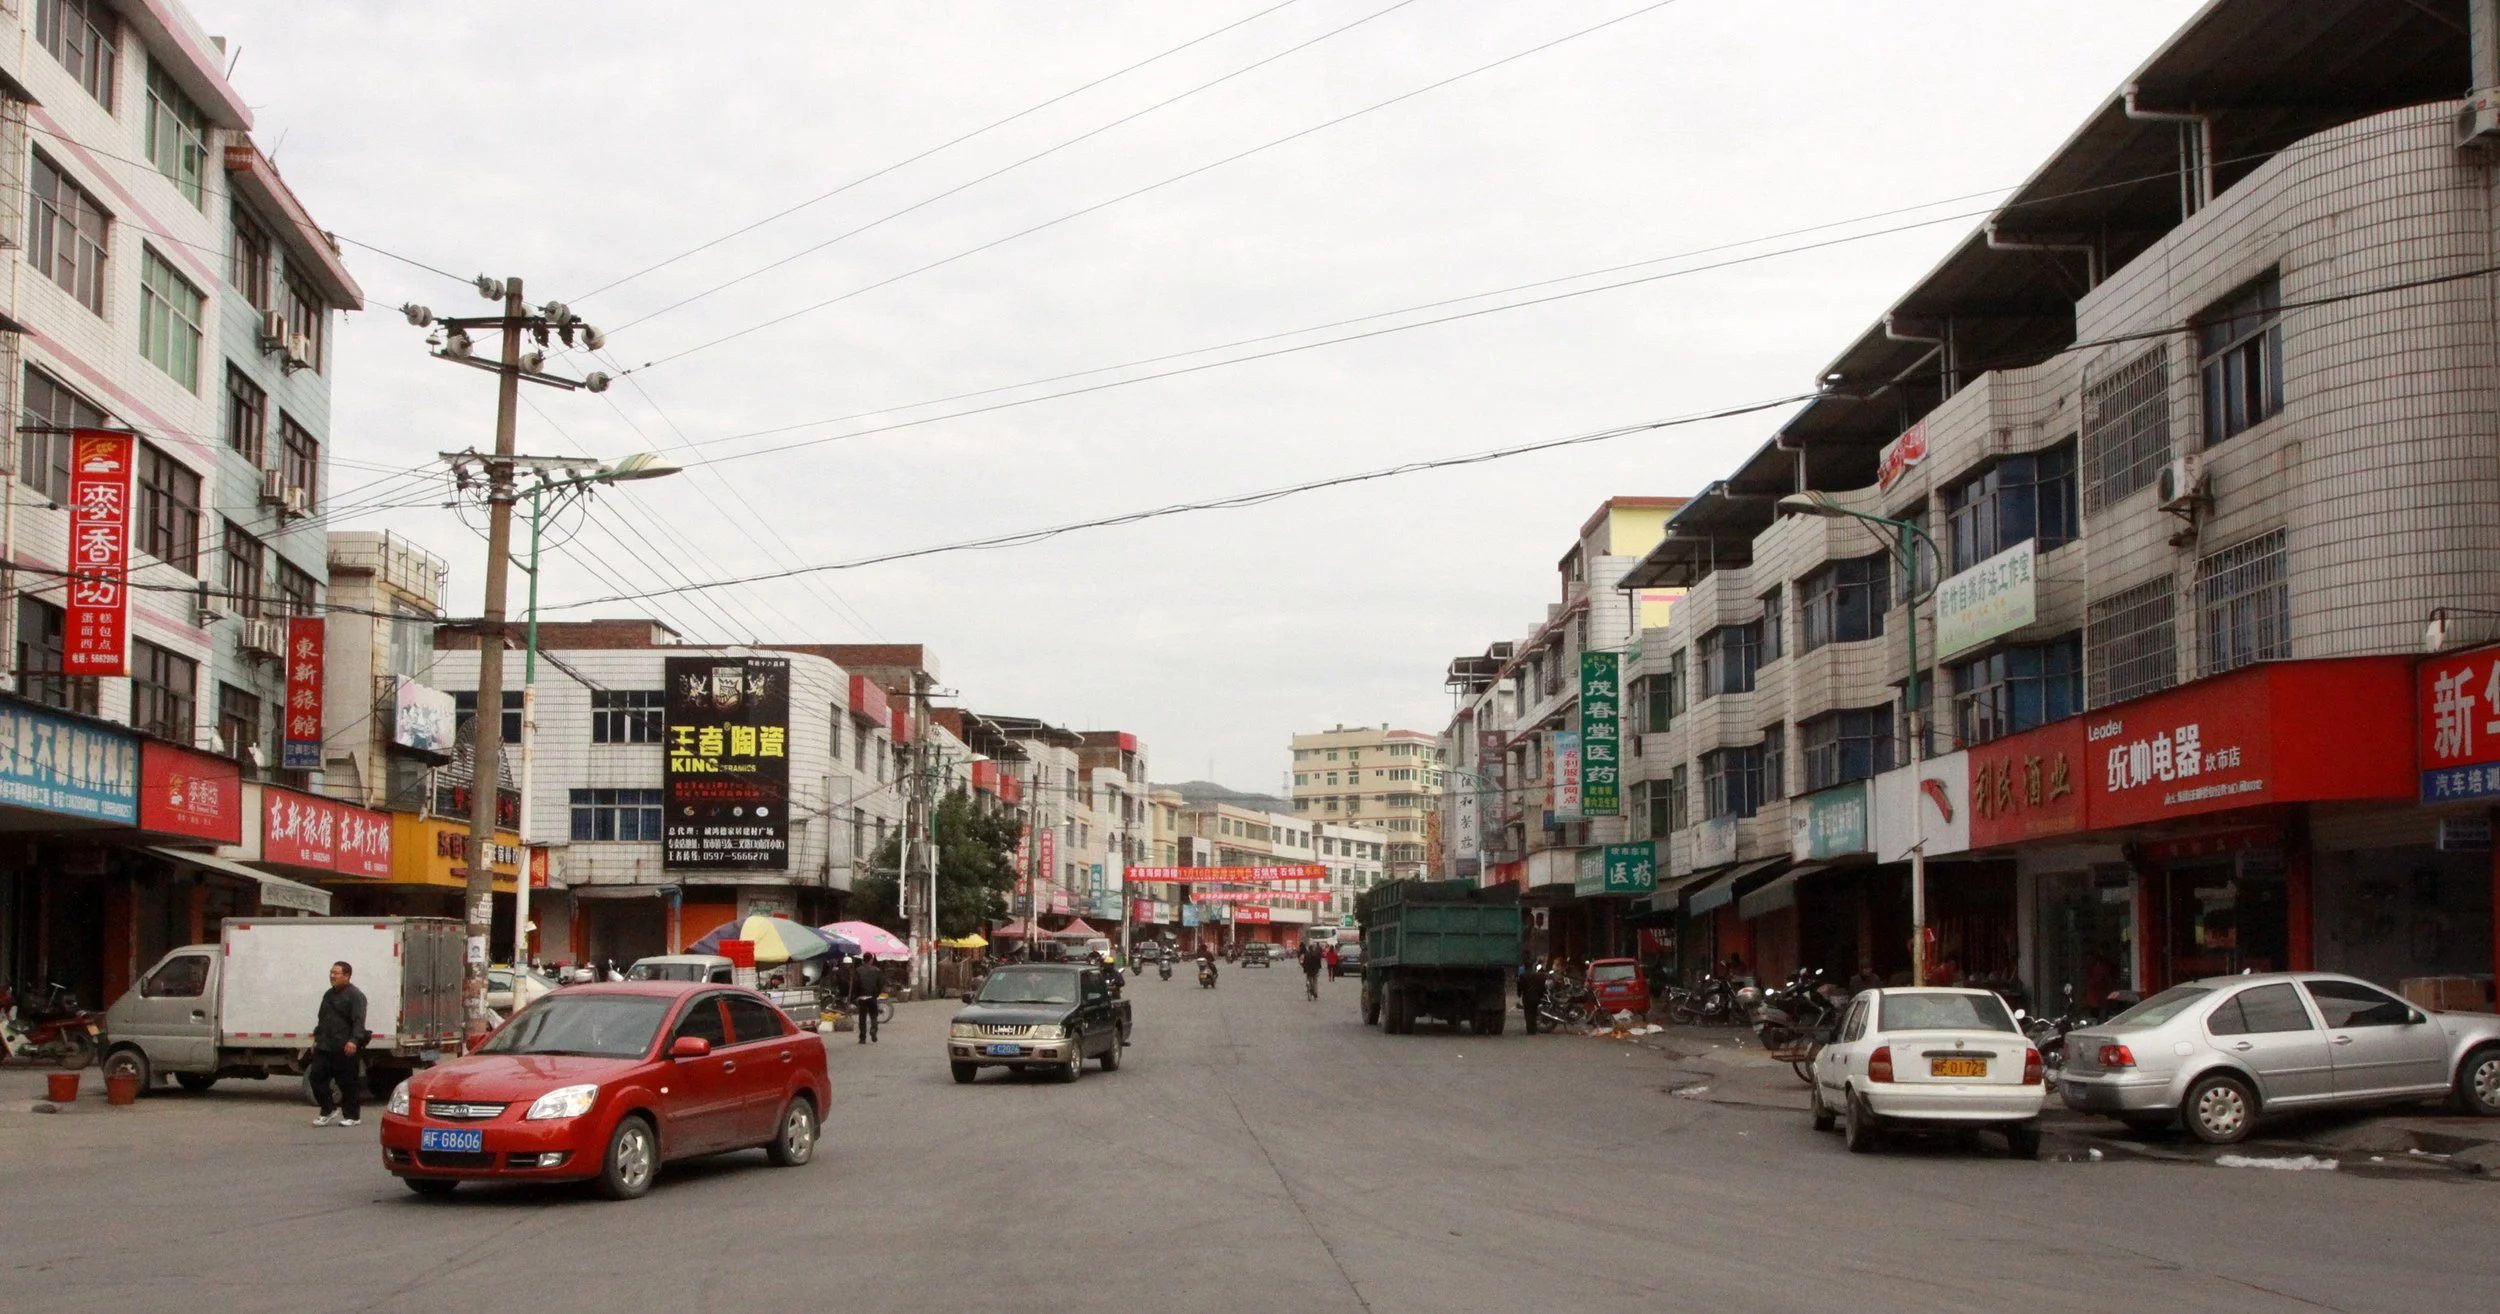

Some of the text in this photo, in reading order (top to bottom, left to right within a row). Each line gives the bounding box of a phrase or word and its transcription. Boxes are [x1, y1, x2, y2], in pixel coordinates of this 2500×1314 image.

[1585, 680, 1617, 784] 茂春堂医药
[2088, 719, 2123, 742] Leader
[671, 758, 718, 773] KING
[2107, 724, 2241, 792] 统帅电器 坎市店
[1976, 752, 2071, 820] 利民酒业
[2436, 766, 2500, 797] 汽车培训
[1610, 860, 1652, 887] 医药
